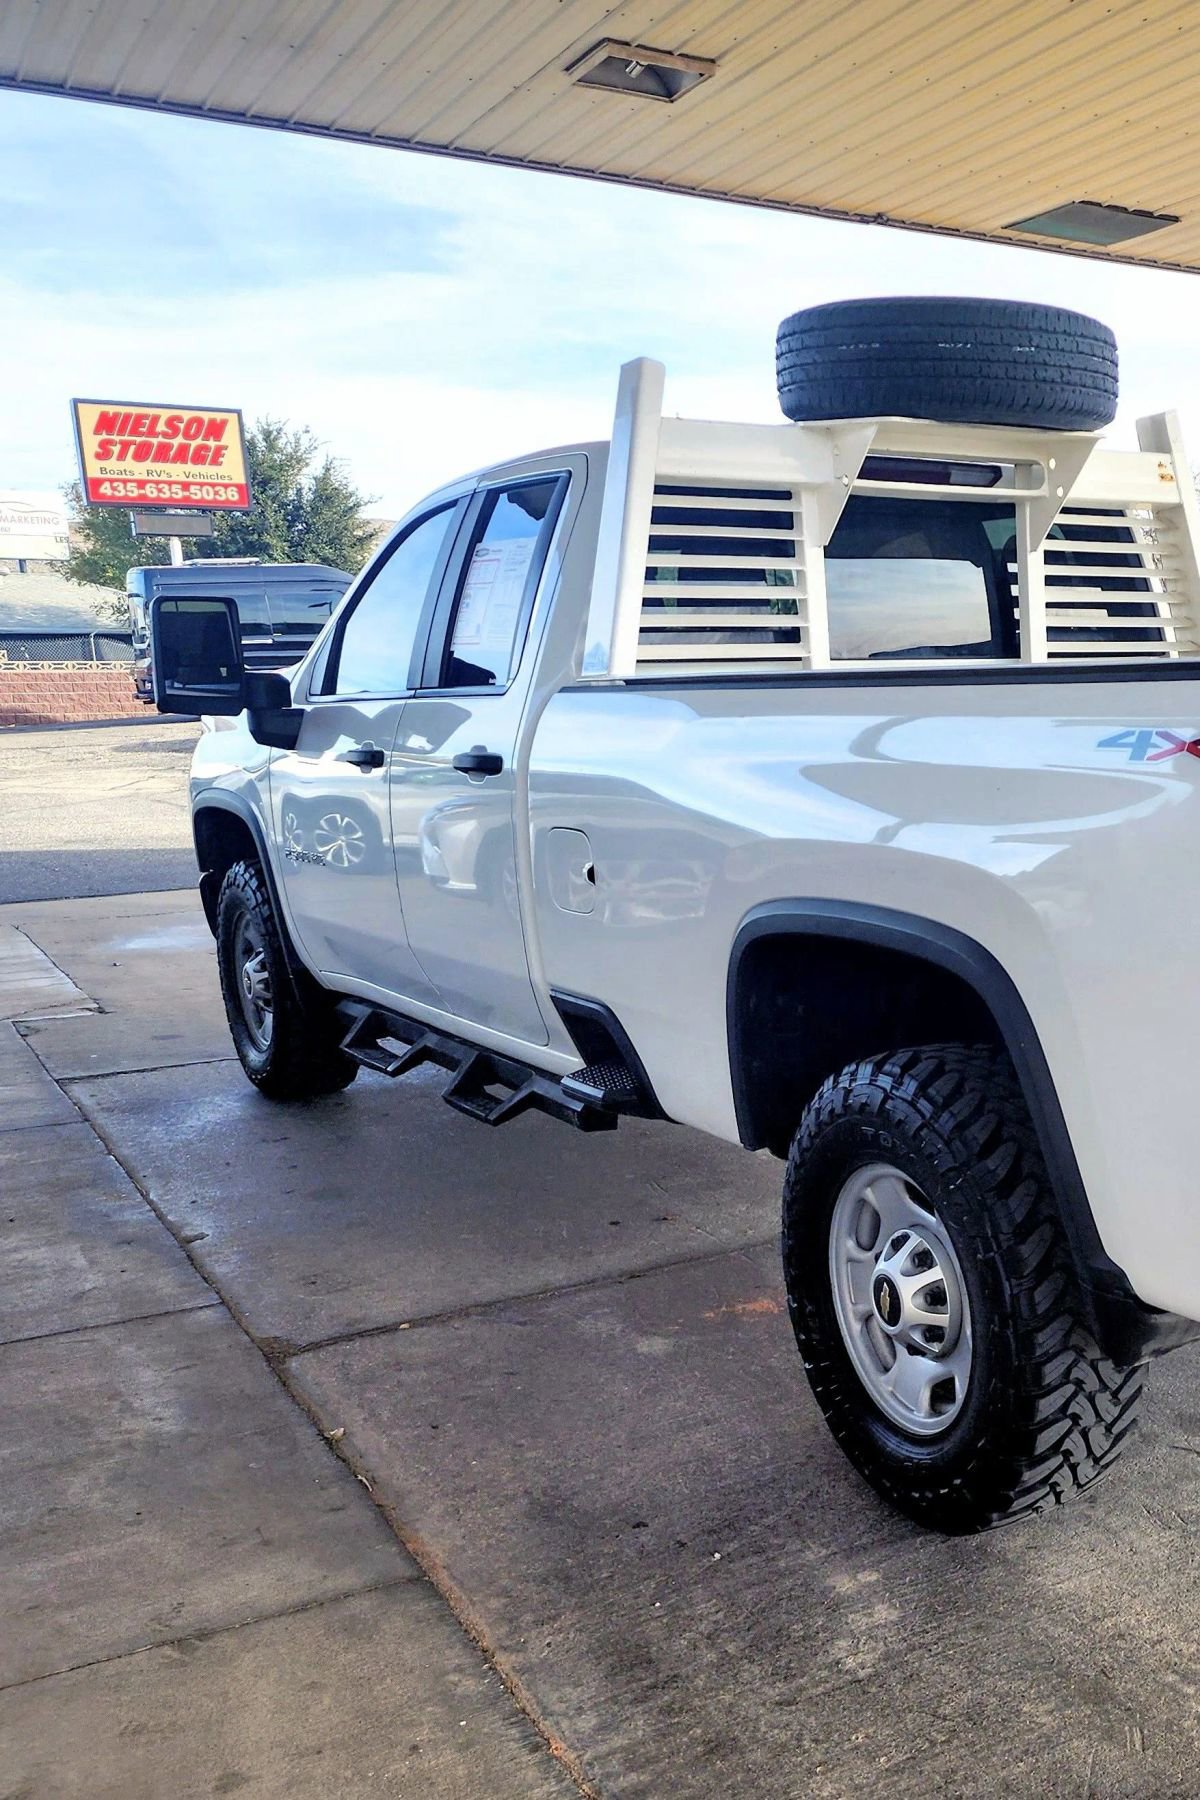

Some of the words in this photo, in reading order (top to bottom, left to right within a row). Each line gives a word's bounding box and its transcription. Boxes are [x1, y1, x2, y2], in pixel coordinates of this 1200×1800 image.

[93, 411, 229, 442] NIELSON
[94, 438, 229, 467] STORAGE
[100, 467, 135, 477] Boats
[146, 469, 173, 479] RV's
[183, 471, 233, 481] Vehicles
[99, 480, 240, 501] 435-635-5036
